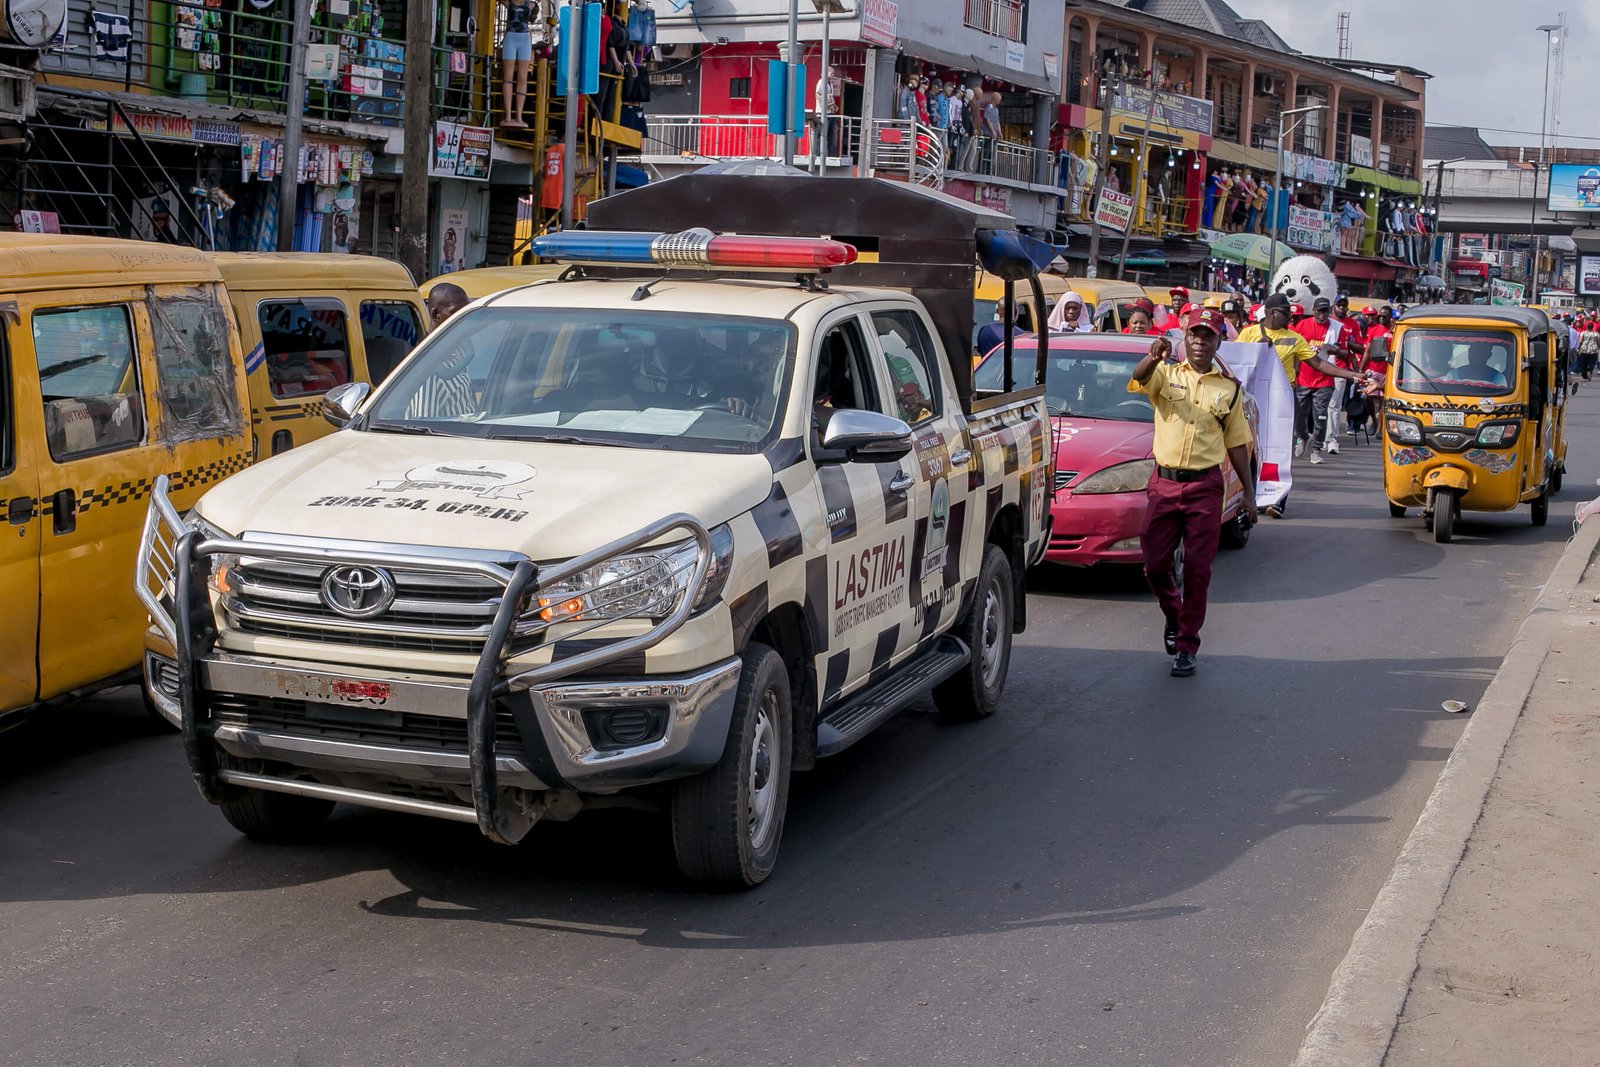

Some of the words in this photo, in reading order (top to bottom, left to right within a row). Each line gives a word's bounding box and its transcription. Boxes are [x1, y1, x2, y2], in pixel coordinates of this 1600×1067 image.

[134, 113, 159, 135] BEST
[160, 115, 193, 138] SHOES
[447, 134, 459, 146] LG
[1104, 191, 1115, 200] TO
[1116, 195, 1131, 205] LET
[920, 439, 930, 449] TOLL
[930, 436, 940, 447] FREE
[307, 496, 386, 507] ZONE
[835, 535, 905, 610] LASTMA
[852, 603, 866, 627] TRAFFIC
[865, 593, 888, 621] MANAGEMENT
